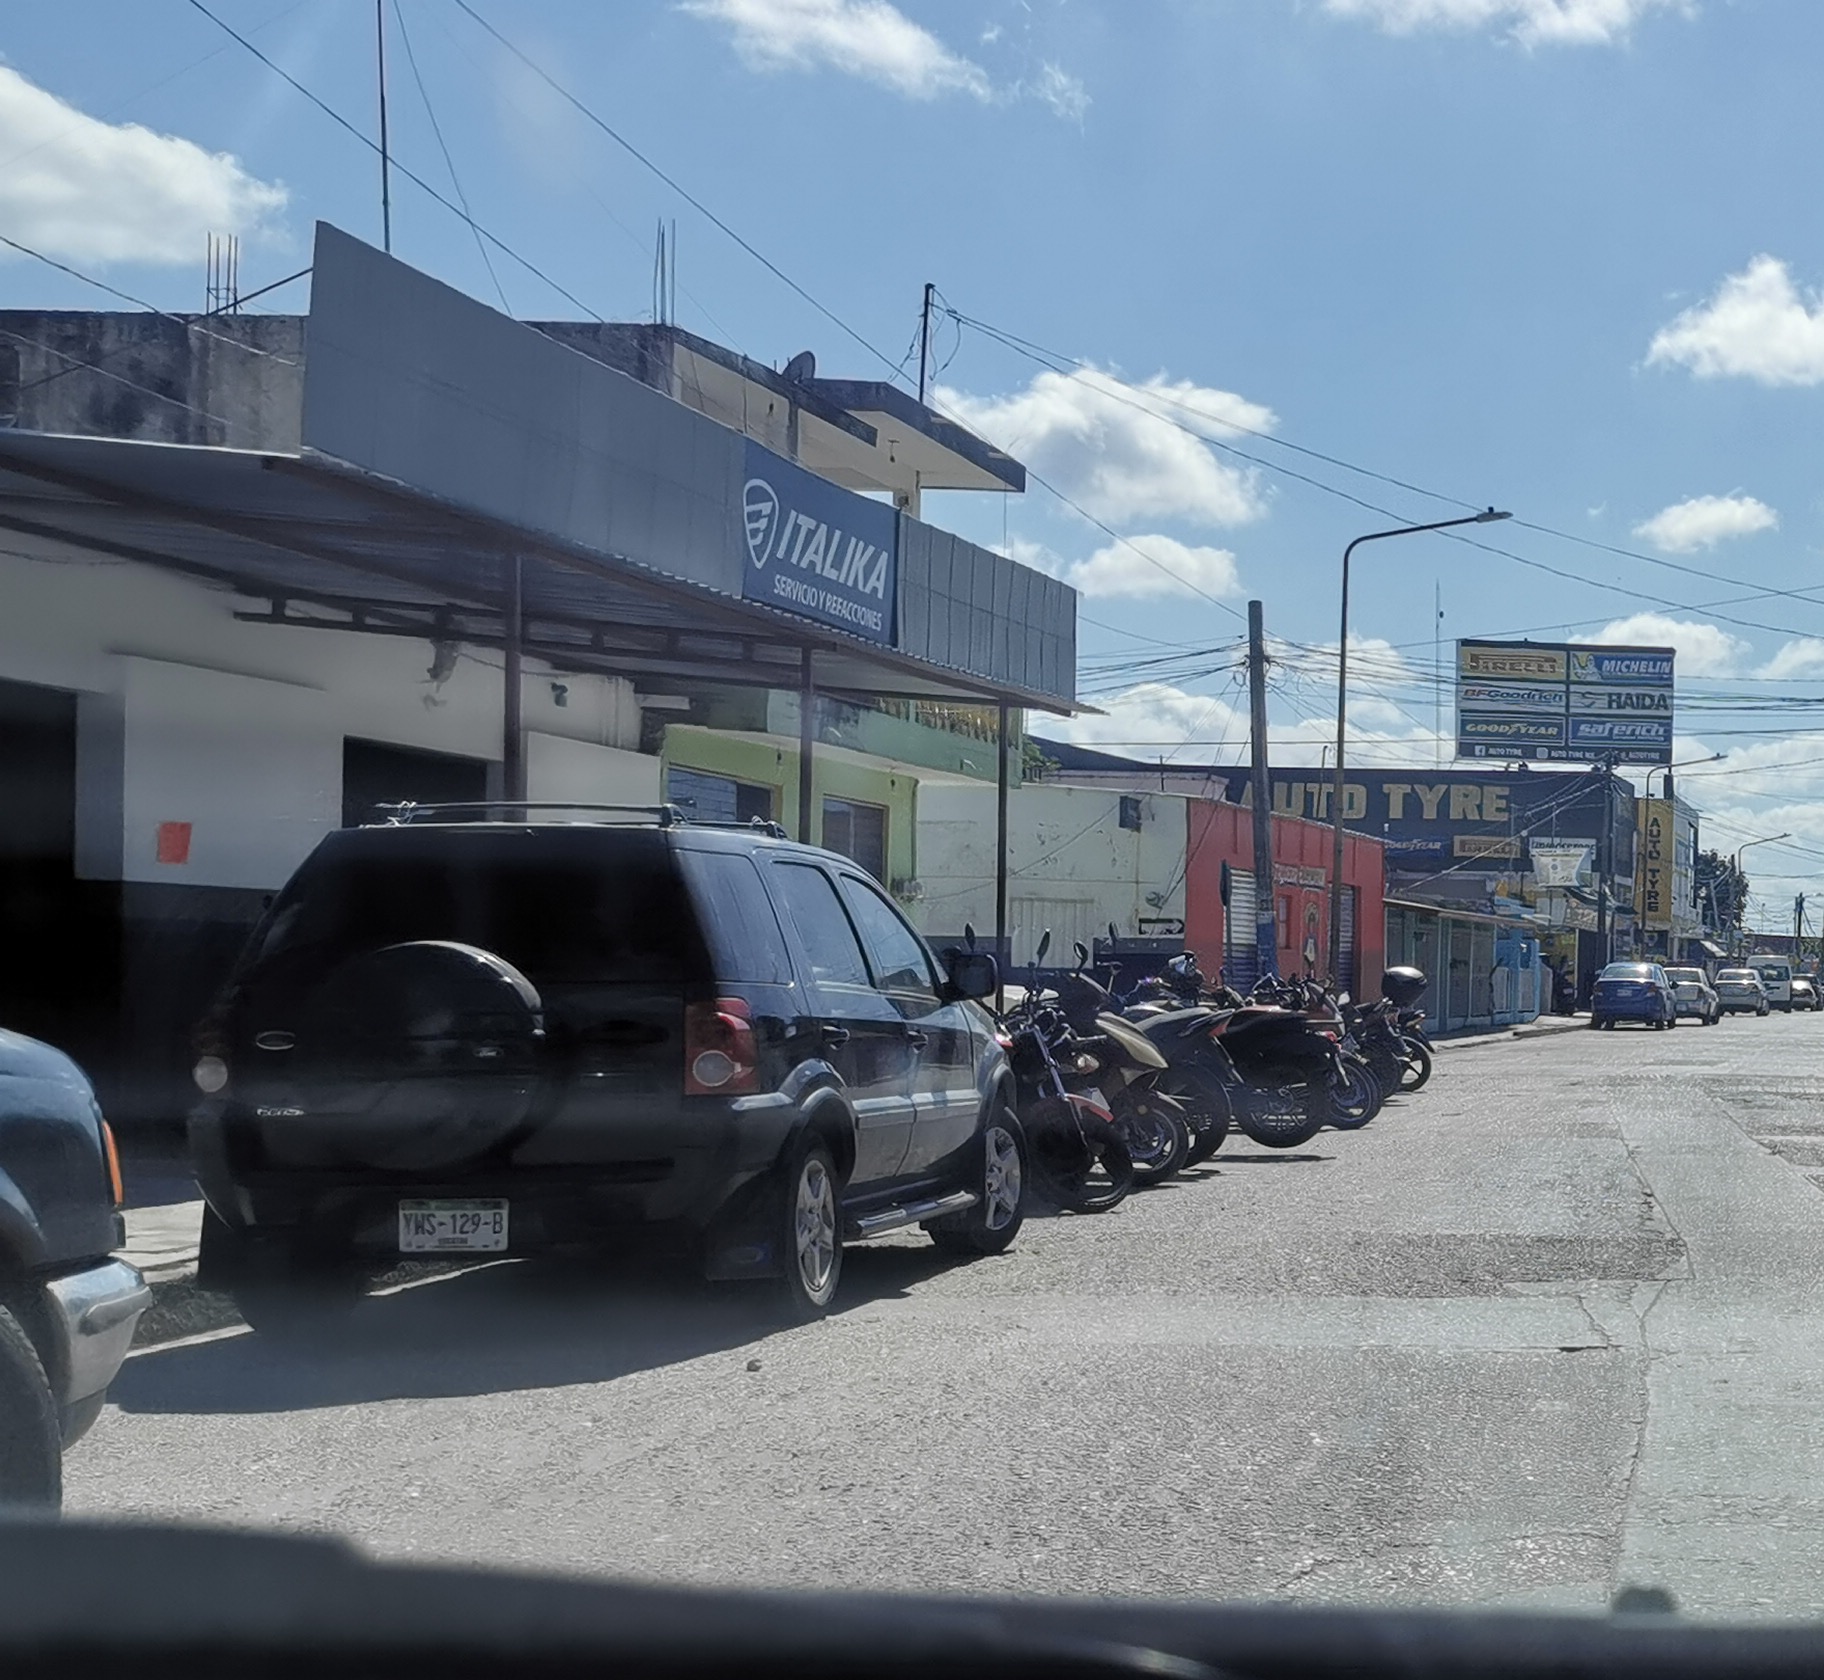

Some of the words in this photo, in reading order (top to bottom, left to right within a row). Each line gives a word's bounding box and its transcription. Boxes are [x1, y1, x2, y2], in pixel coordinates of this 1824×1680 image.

[776, 509, 889, 599] ITALIKA
[773, 573, 818, 607] SERVICIO
[818, 590, 826, 610] Y
[824, 593, 883, 632] REFACCIONES
[1601, 659, 1671, 675] MICHELIN
[1463, 688, 1563, 702] BFGoodrich
[1606, 692, 1670, 711] HAIDA
[1465, 722, 1559, 736] GOODYEAR
[1383, 783, 1510, 821] TYRE
